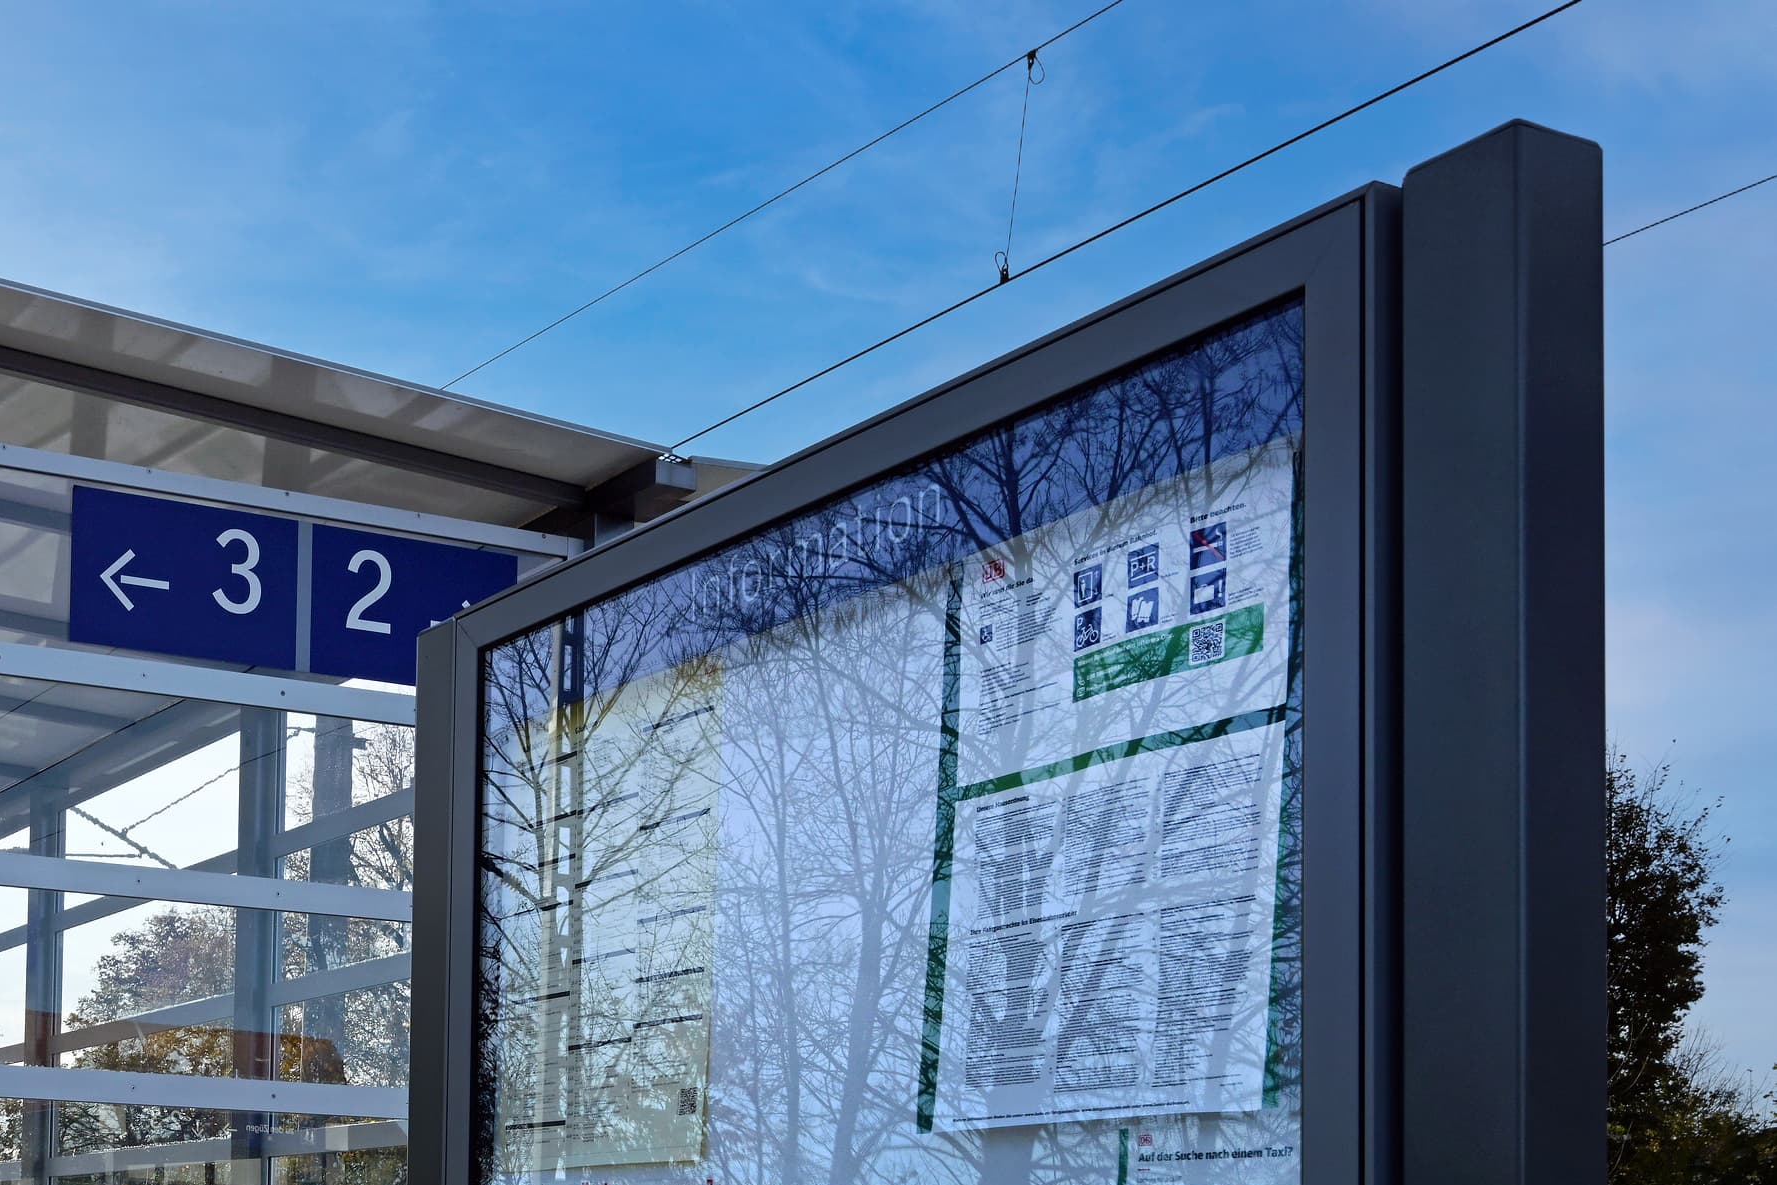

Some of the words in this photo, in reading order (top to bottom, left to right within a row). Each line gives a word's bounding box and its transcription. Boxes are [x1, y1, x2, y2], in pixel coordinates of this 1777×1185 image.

[212, 528, 262, 615] 3
[345, 549, 393, 634] 2
[691, 482, 941, 620] Information
[1130, 556, 1156, 578] P+R
[1138, 1151, 1156, 1162] Auf
[1157, 1151, 1173, 1162] der
[1174, 1150, 1204, 1161] Suche
[1205, 1149, 1230, 1160] nach
[1231, 1148, 1263, 1159] einem
[1264, 1145, 1294, 1158] Taxi?
